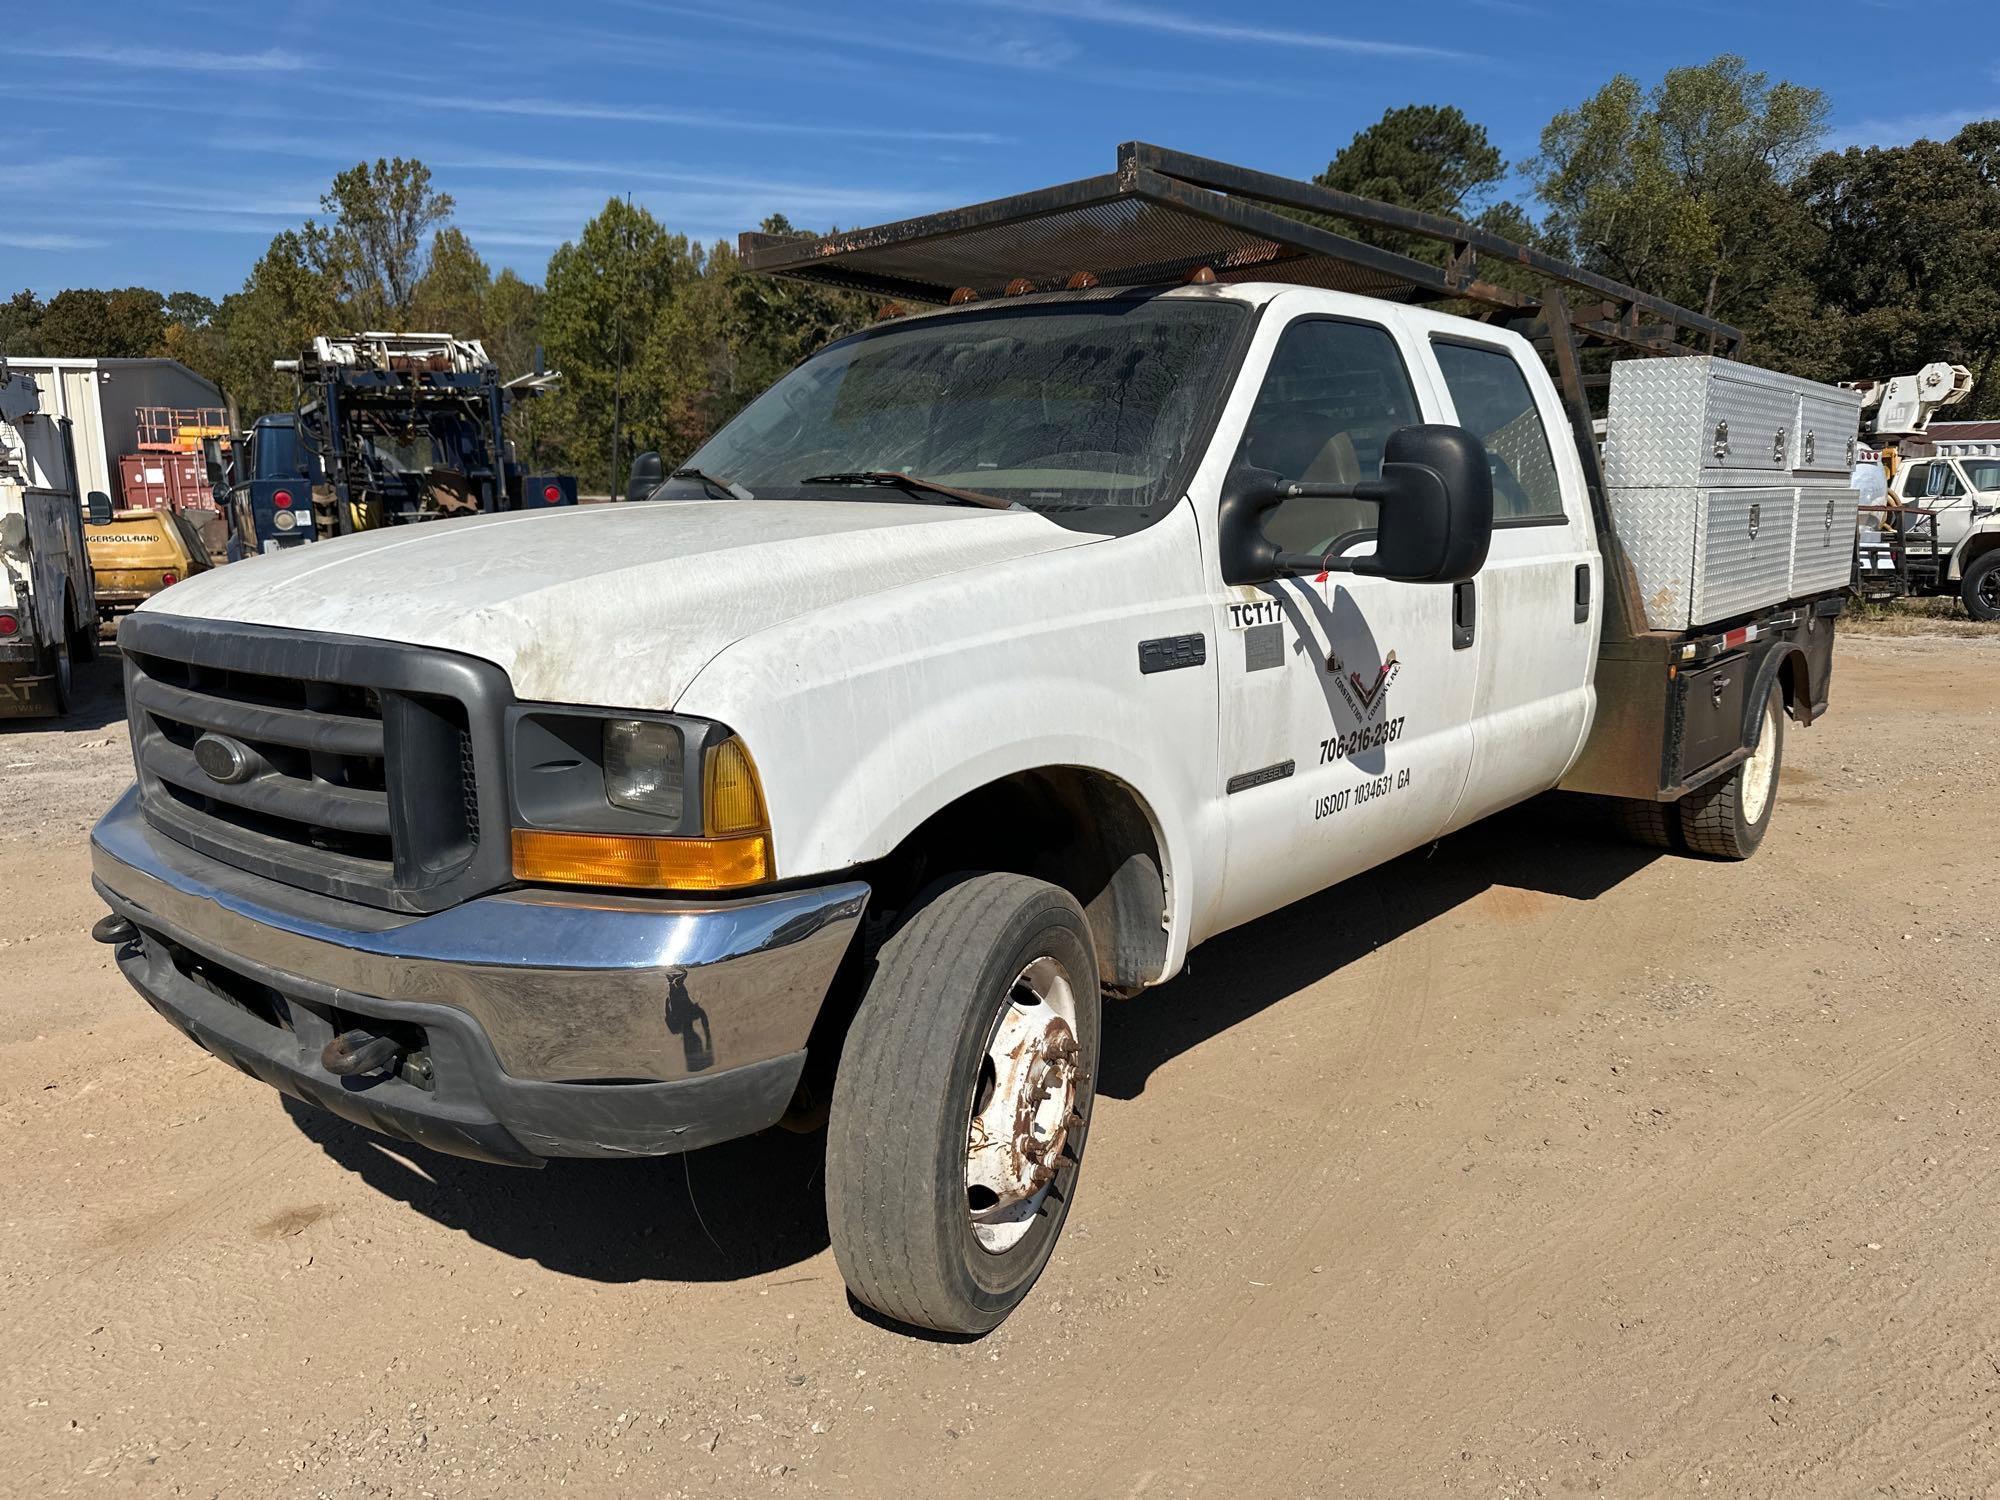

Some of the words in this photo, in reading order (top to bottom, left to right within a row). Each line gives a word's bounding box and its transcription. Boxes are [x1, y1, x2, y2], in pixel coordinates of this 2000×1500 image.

[1230, 600, 1283, 628] TCT17
[1320, 716, 1405, 765] 706-216-2387
[1315, 788, 1351, 820] USDOT
[1354, 774, 1393, 806] 1034631
[1397, 767, 1410, 789] GA
